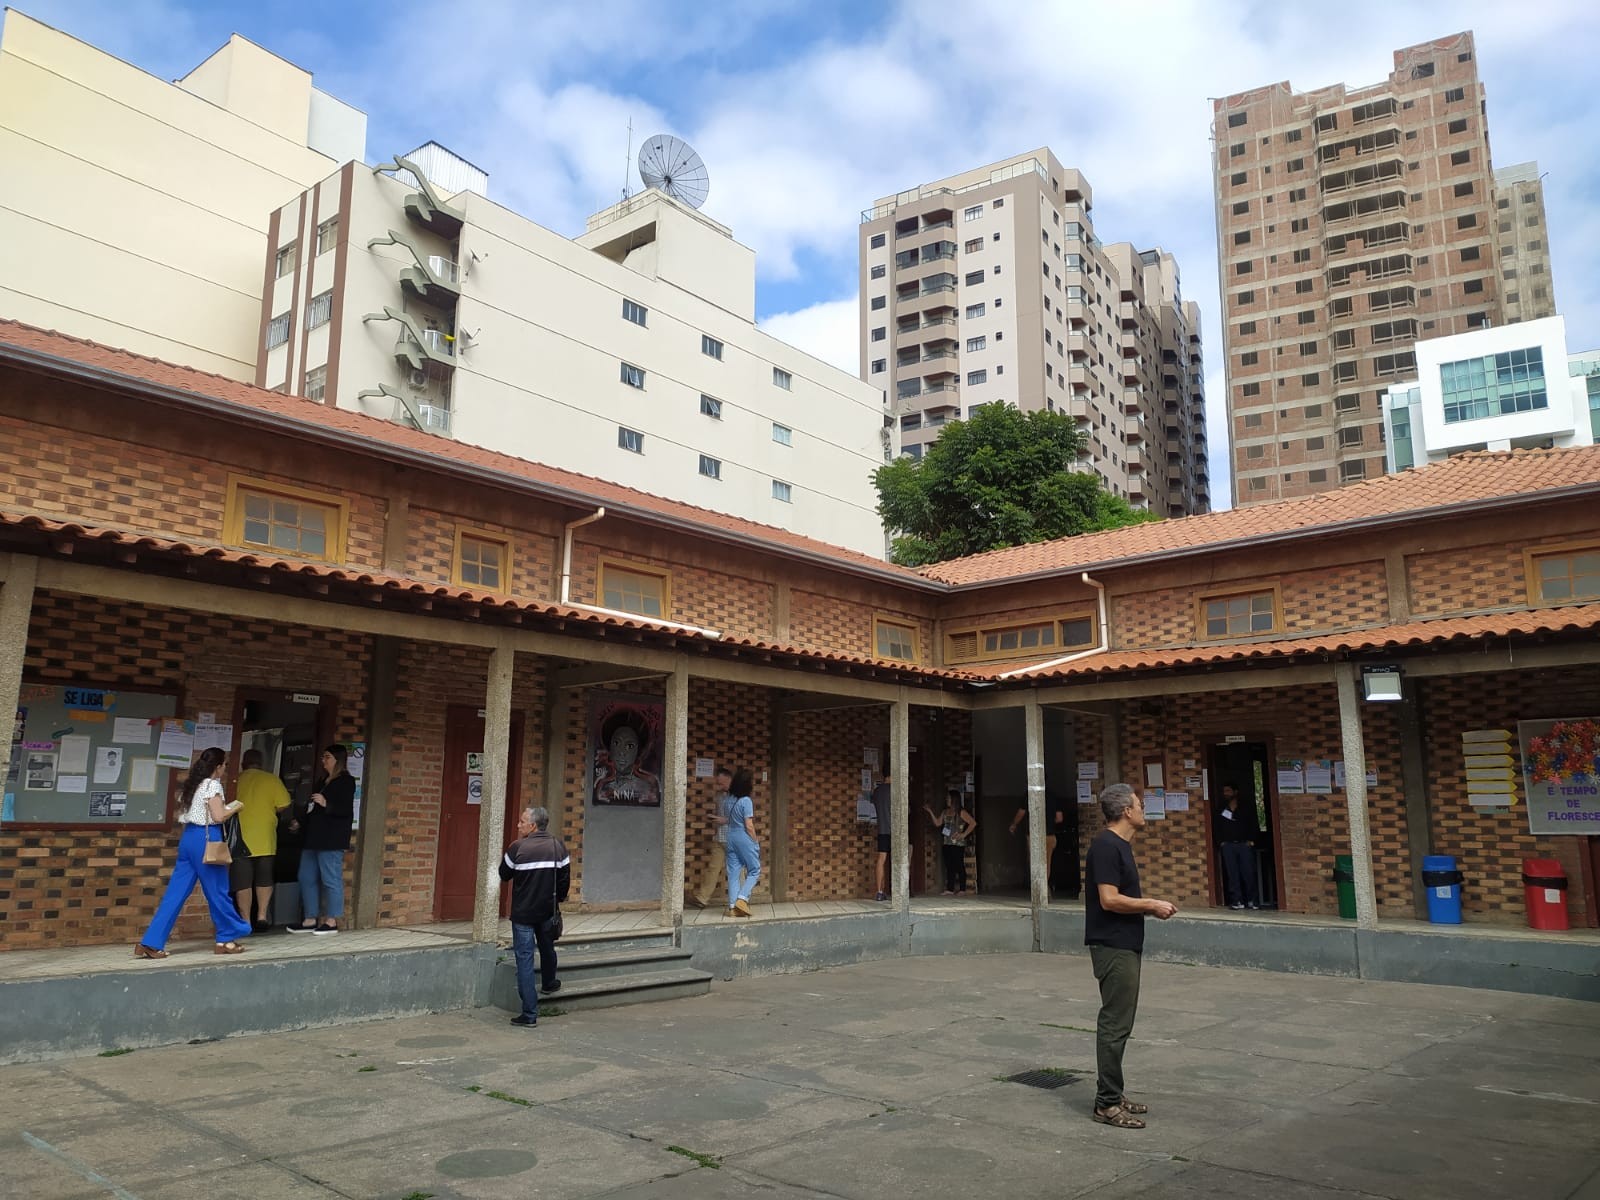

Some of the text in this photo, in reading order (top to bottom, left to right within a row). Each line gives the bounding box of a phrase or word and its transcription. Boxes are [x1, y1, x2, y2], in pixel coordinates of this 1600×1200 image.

[64, 690, 78, 704] SE
[80, 692, 103, 707] LIGA
[613, 788, 635, 801] NINA
[1560, 786, 1598, 795] TEMPO
[1566, 800, 1581, 808] DE
[1547, 811, 1600, 821] FLORESCE
